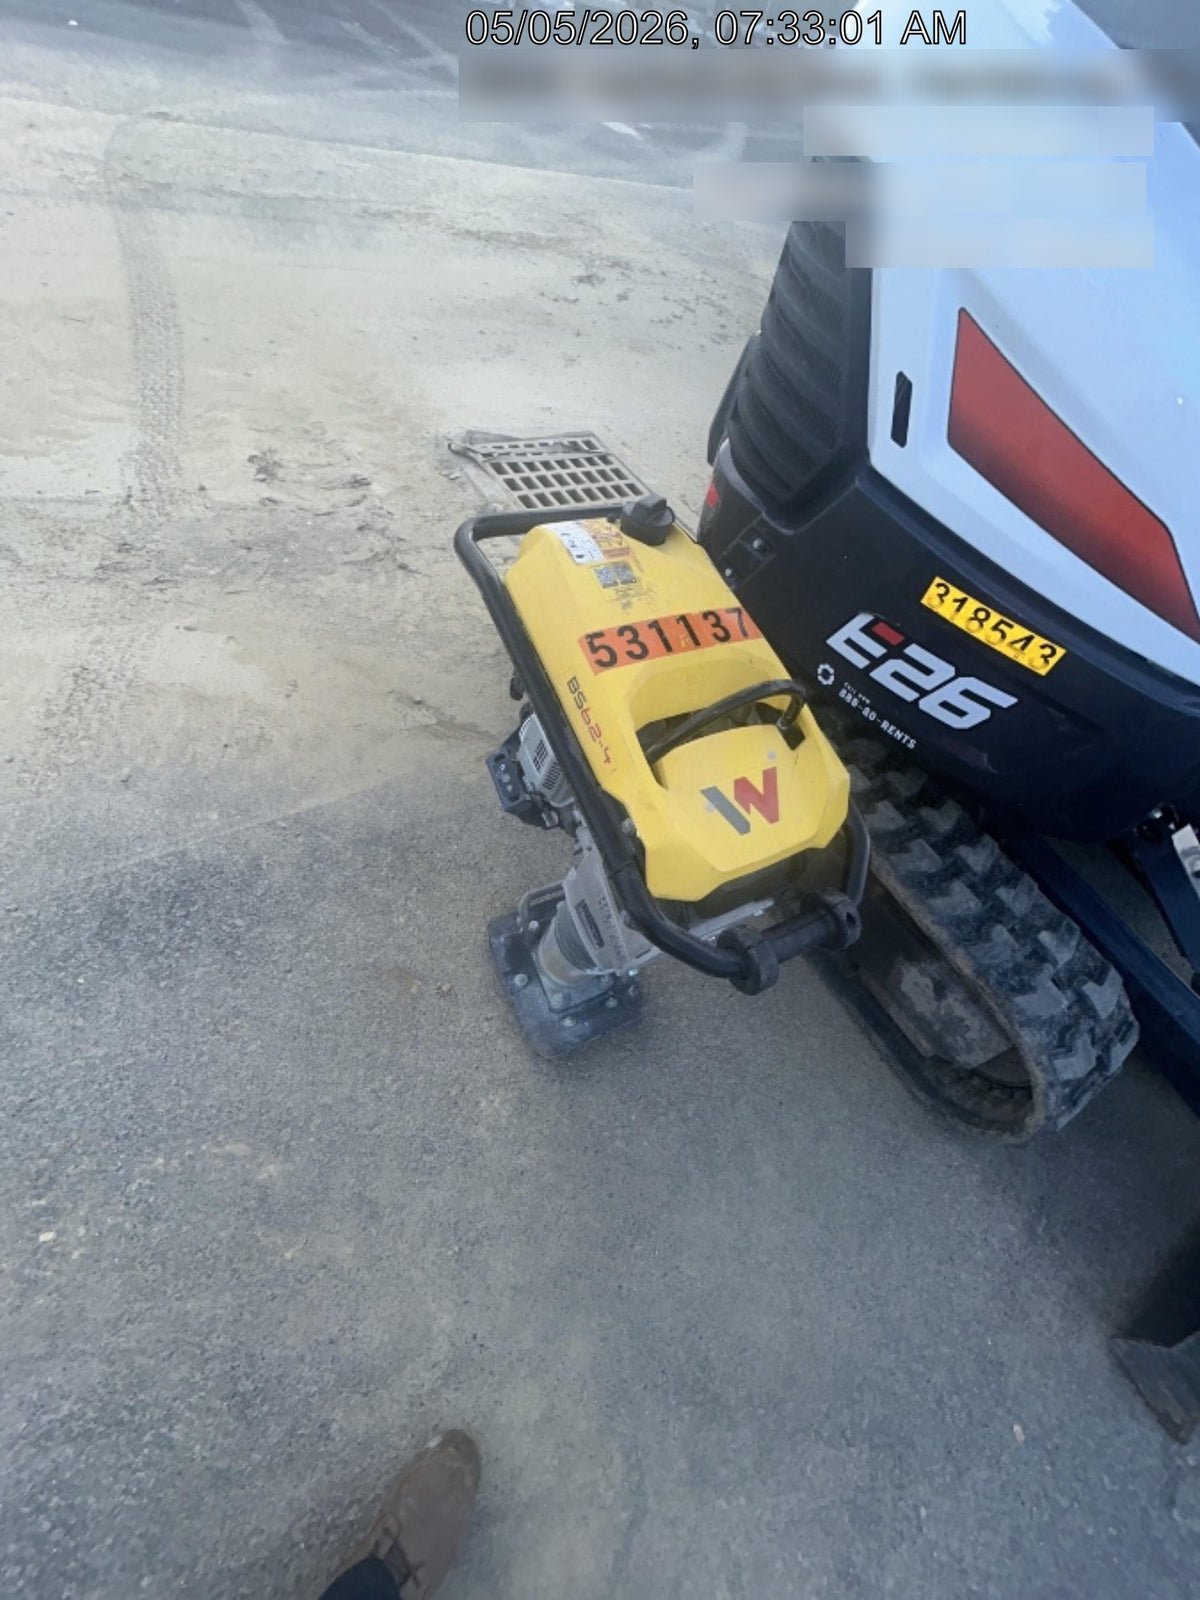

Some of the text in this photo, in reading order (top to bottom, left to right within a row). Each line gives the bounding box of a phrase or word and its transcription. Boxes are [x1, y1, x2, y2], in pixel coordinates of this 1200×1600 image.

[585, 607, 749, 668] 531137
[927, 582, 1057, 671] 318543
[567, 676, 611, 763] BS62-4
